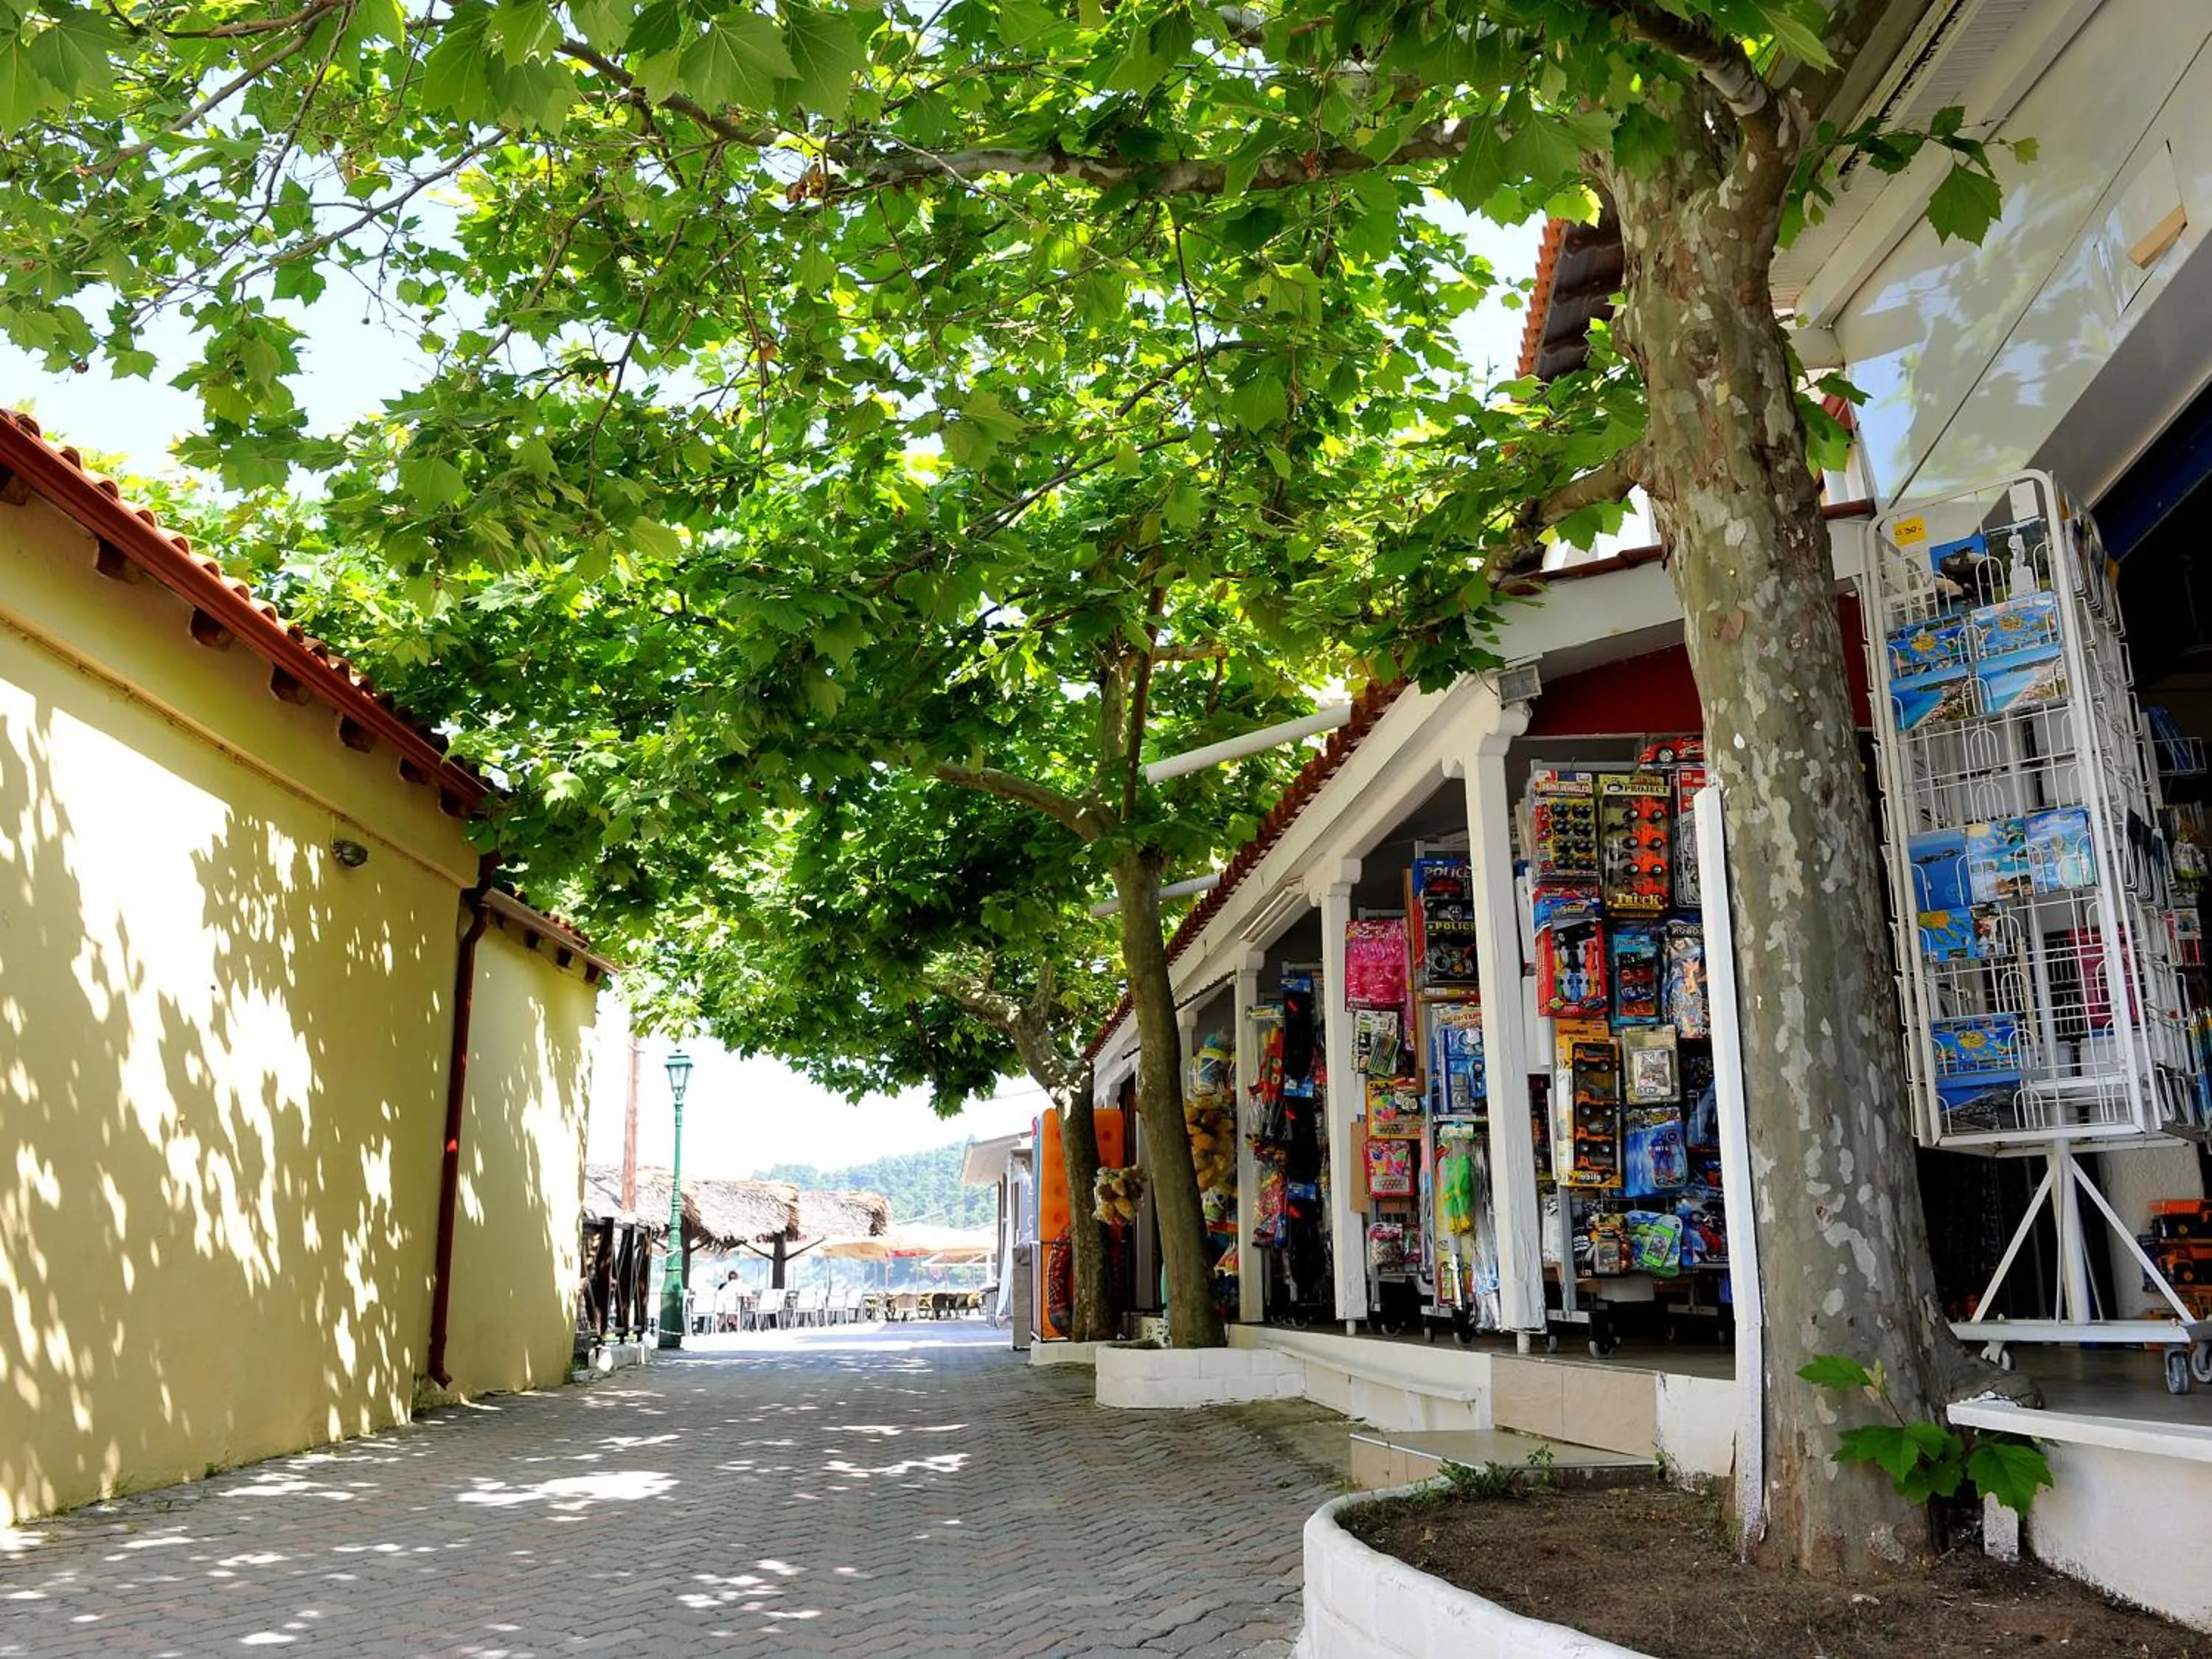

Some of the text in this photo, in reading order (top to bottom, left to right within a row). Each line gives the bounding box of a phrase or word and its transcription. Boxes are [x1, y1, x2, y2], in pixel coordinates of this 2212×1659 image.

[1624, 785, 1669, 794] PROJECT
[1424, 866, 1472, 879] POLICE
[1615, 893, 1660, 907] TRUCK
